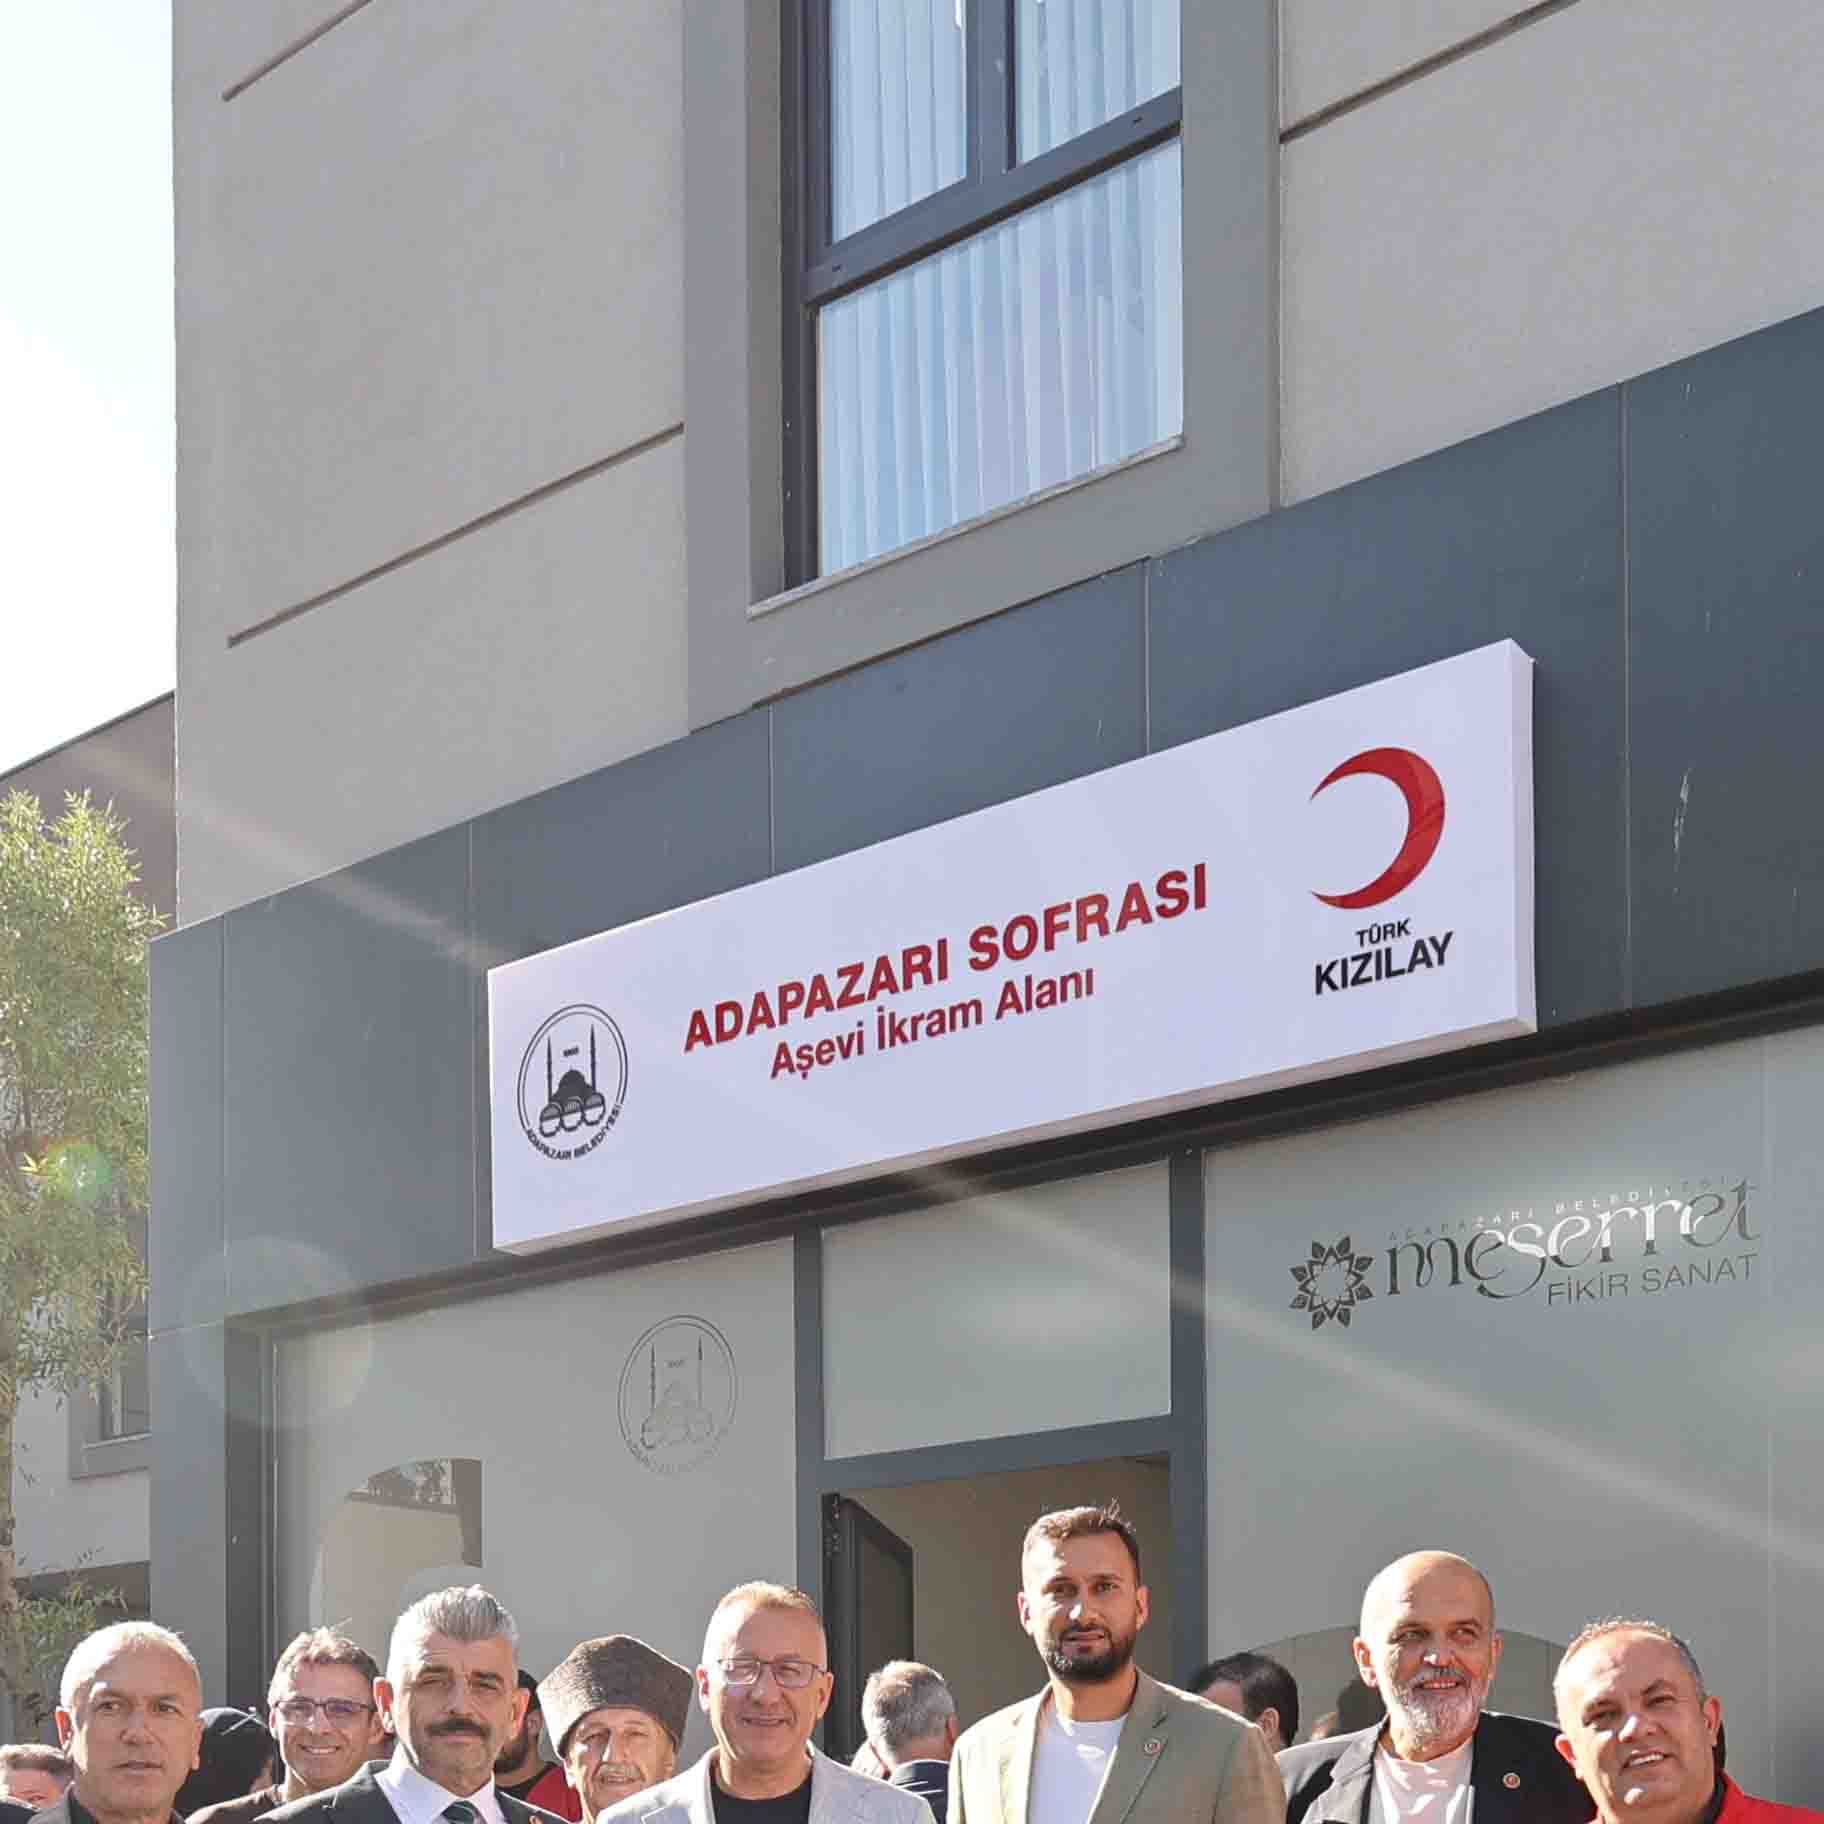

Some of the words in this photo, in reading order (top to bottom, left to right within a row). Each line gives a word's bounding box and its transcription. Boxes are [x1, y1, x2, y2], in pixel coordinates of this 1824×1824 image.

[684, 939, 949, 1052] ADAPAZARI
[968, 863, 1207, 971] SOFRASI
[1314, 930, 1453, 996] KIZILAY
[1355, 917, 1411, 948] TÜRK
[770, 1020, 865, 1080] Aşevi
[877, 996, 983, 1051] İkram
[995, 967, 1094, 1021] Alanı
[1546, 1270, 1630, 1306] FİKİR
[1641, 1253, 1759, 1294] SANAT
